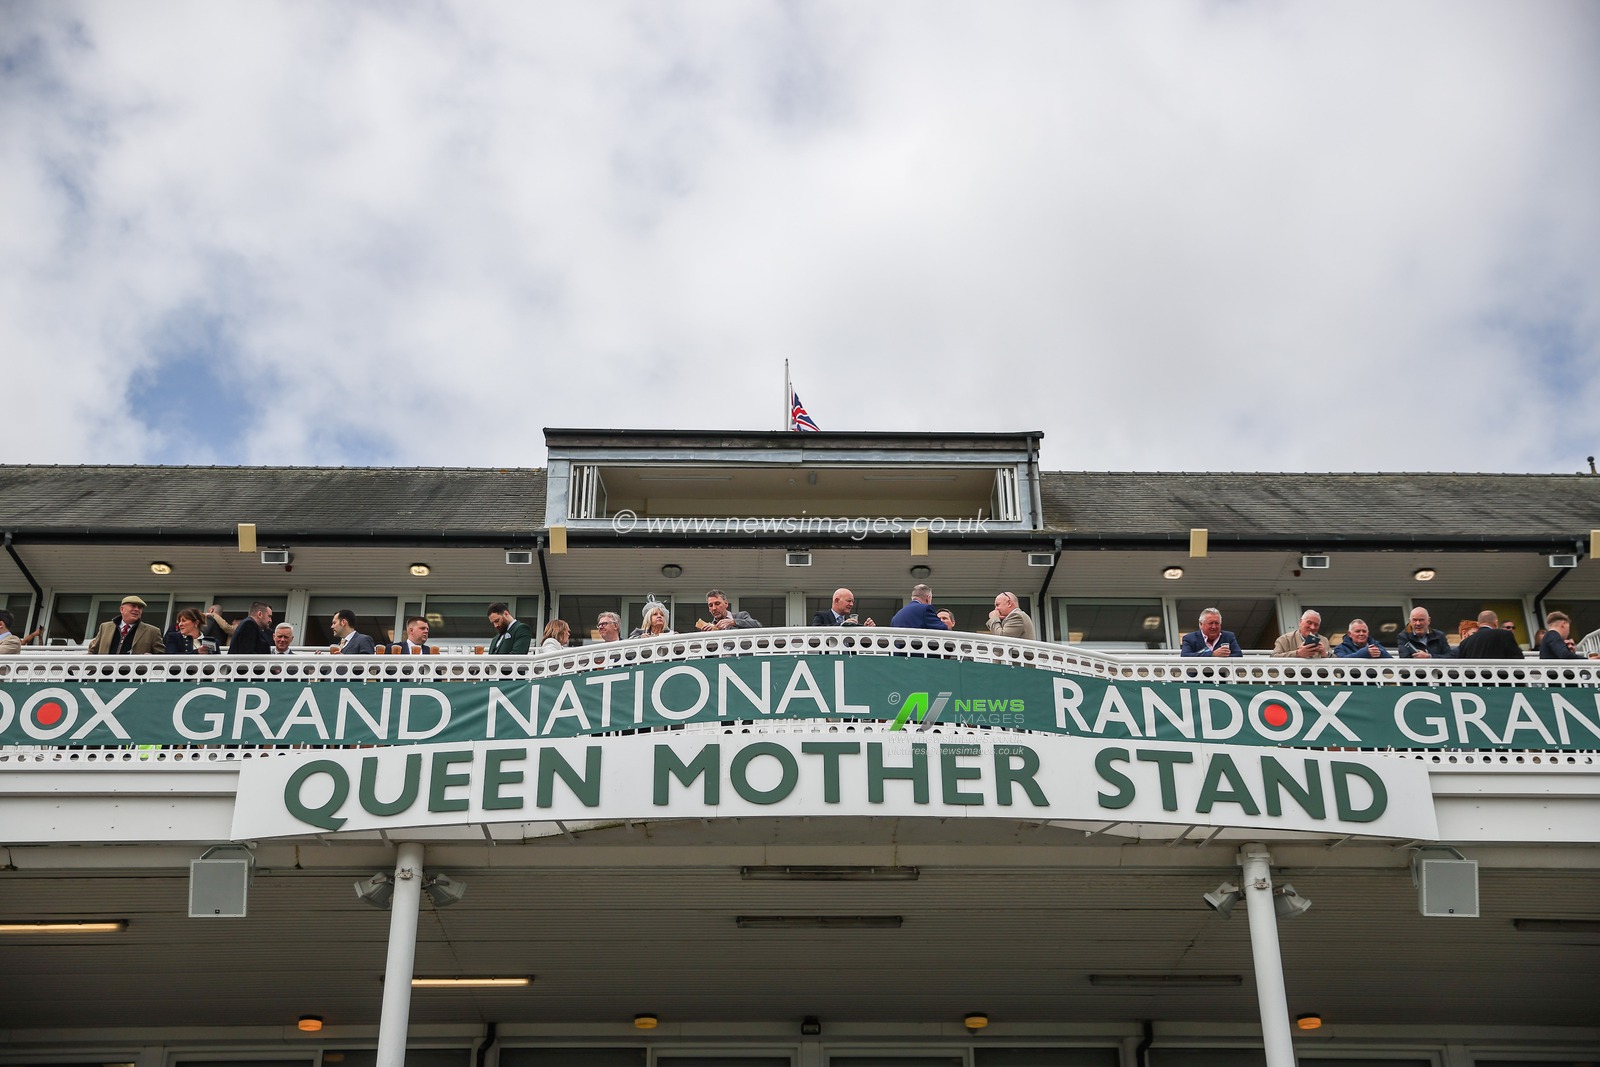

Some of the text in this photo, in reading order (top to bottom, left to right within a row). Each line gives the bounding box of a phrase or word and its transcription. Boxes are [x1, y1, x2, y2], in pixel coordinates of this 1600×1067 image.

[172, 687, 452, 741] GRAND
[486, 660, 870, 738] NATIONAL
[1052, 677, 1361, 742] RANDOX
[284, 741, 1389, 831] QUEEN MOTHER STAND
